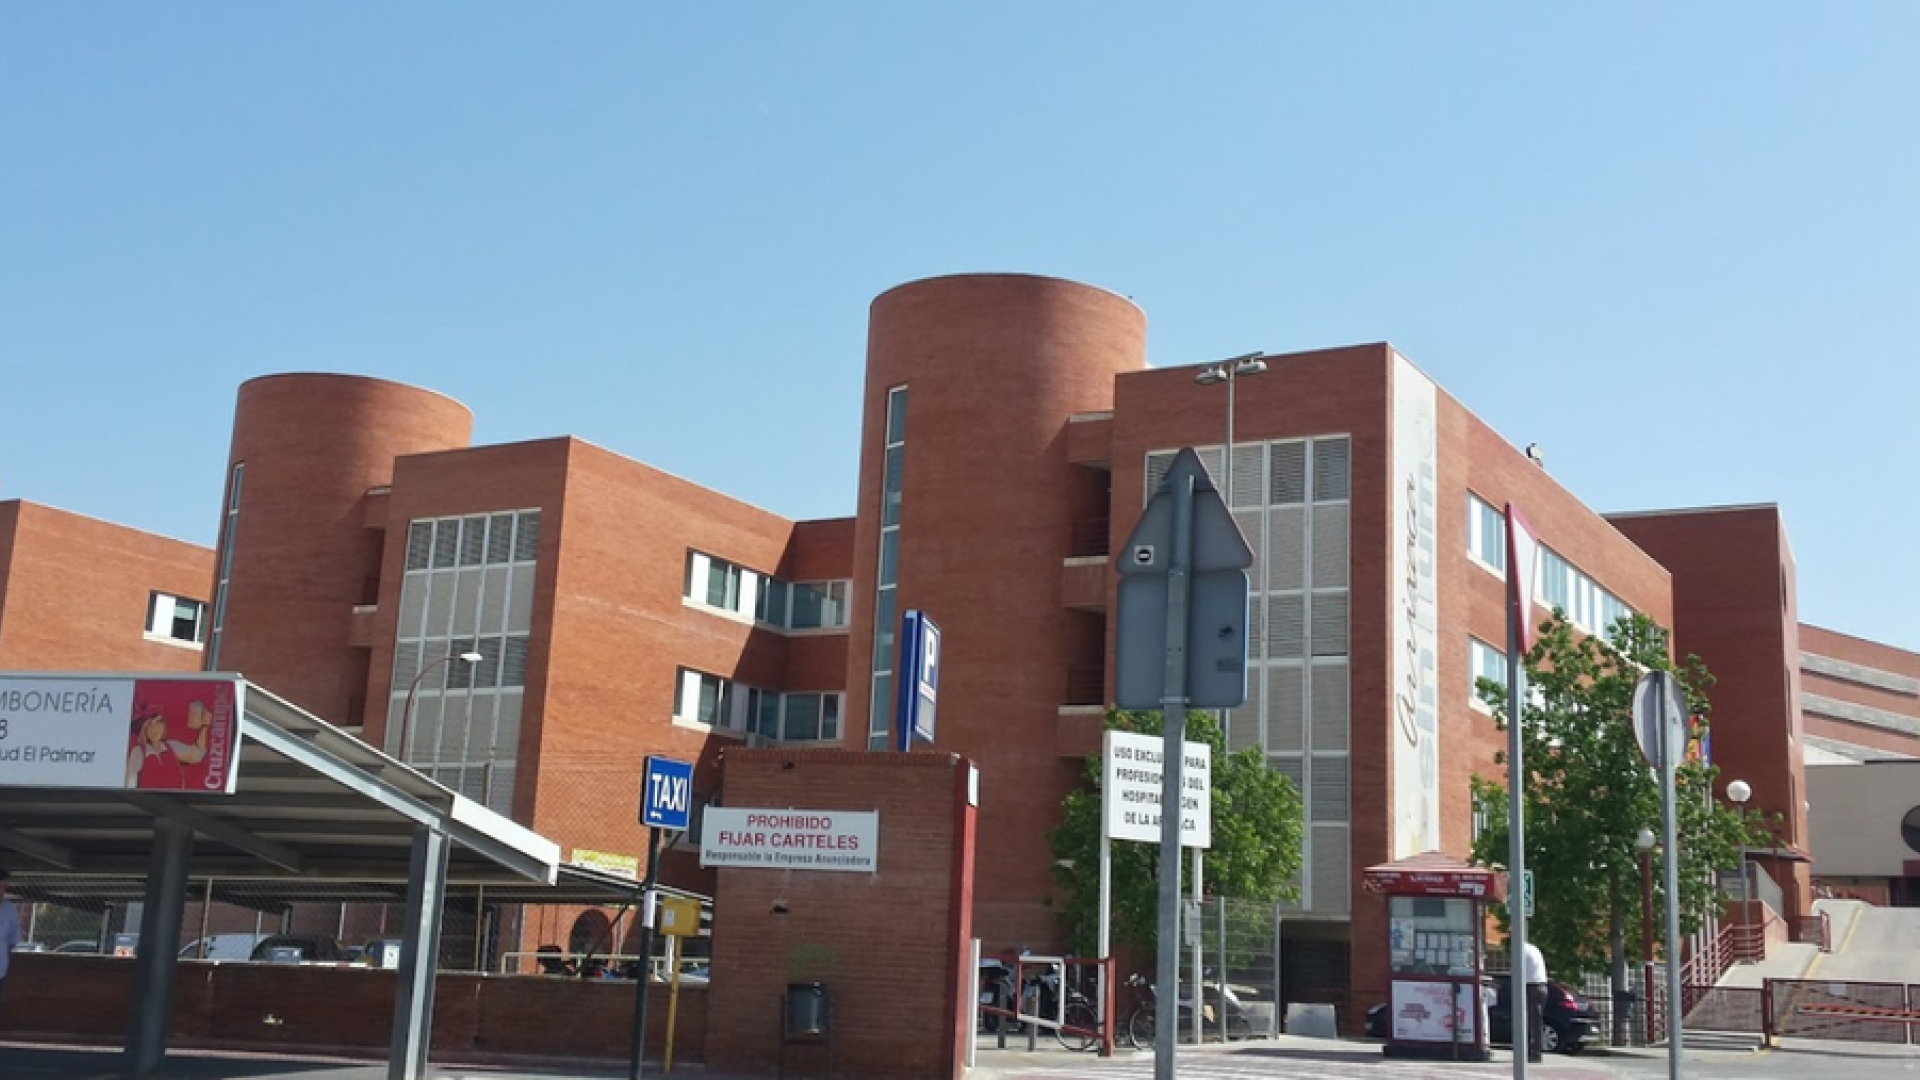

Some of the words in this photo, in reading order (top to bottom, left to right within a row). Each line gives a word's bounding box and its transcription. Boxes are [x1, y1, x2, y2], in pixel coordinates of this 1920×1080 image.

[924, 628, 935, 682] P
[24, 746, 36, 761] El
[40, 746, 96, 763] Palmar
[652, 772, 687, 812] TAXI
[747, 814, 832, 830] PROHIBIDO
[718, 831, 766, 847] FIJAR
[770, 832, 859, 850] CARTELES
[705, 850, 762, 863] Responsable
[765, 851, 773, 862] la
[775, 851, 813, 864] Empresa
[815, 853, 871, 866] Anunciadora
